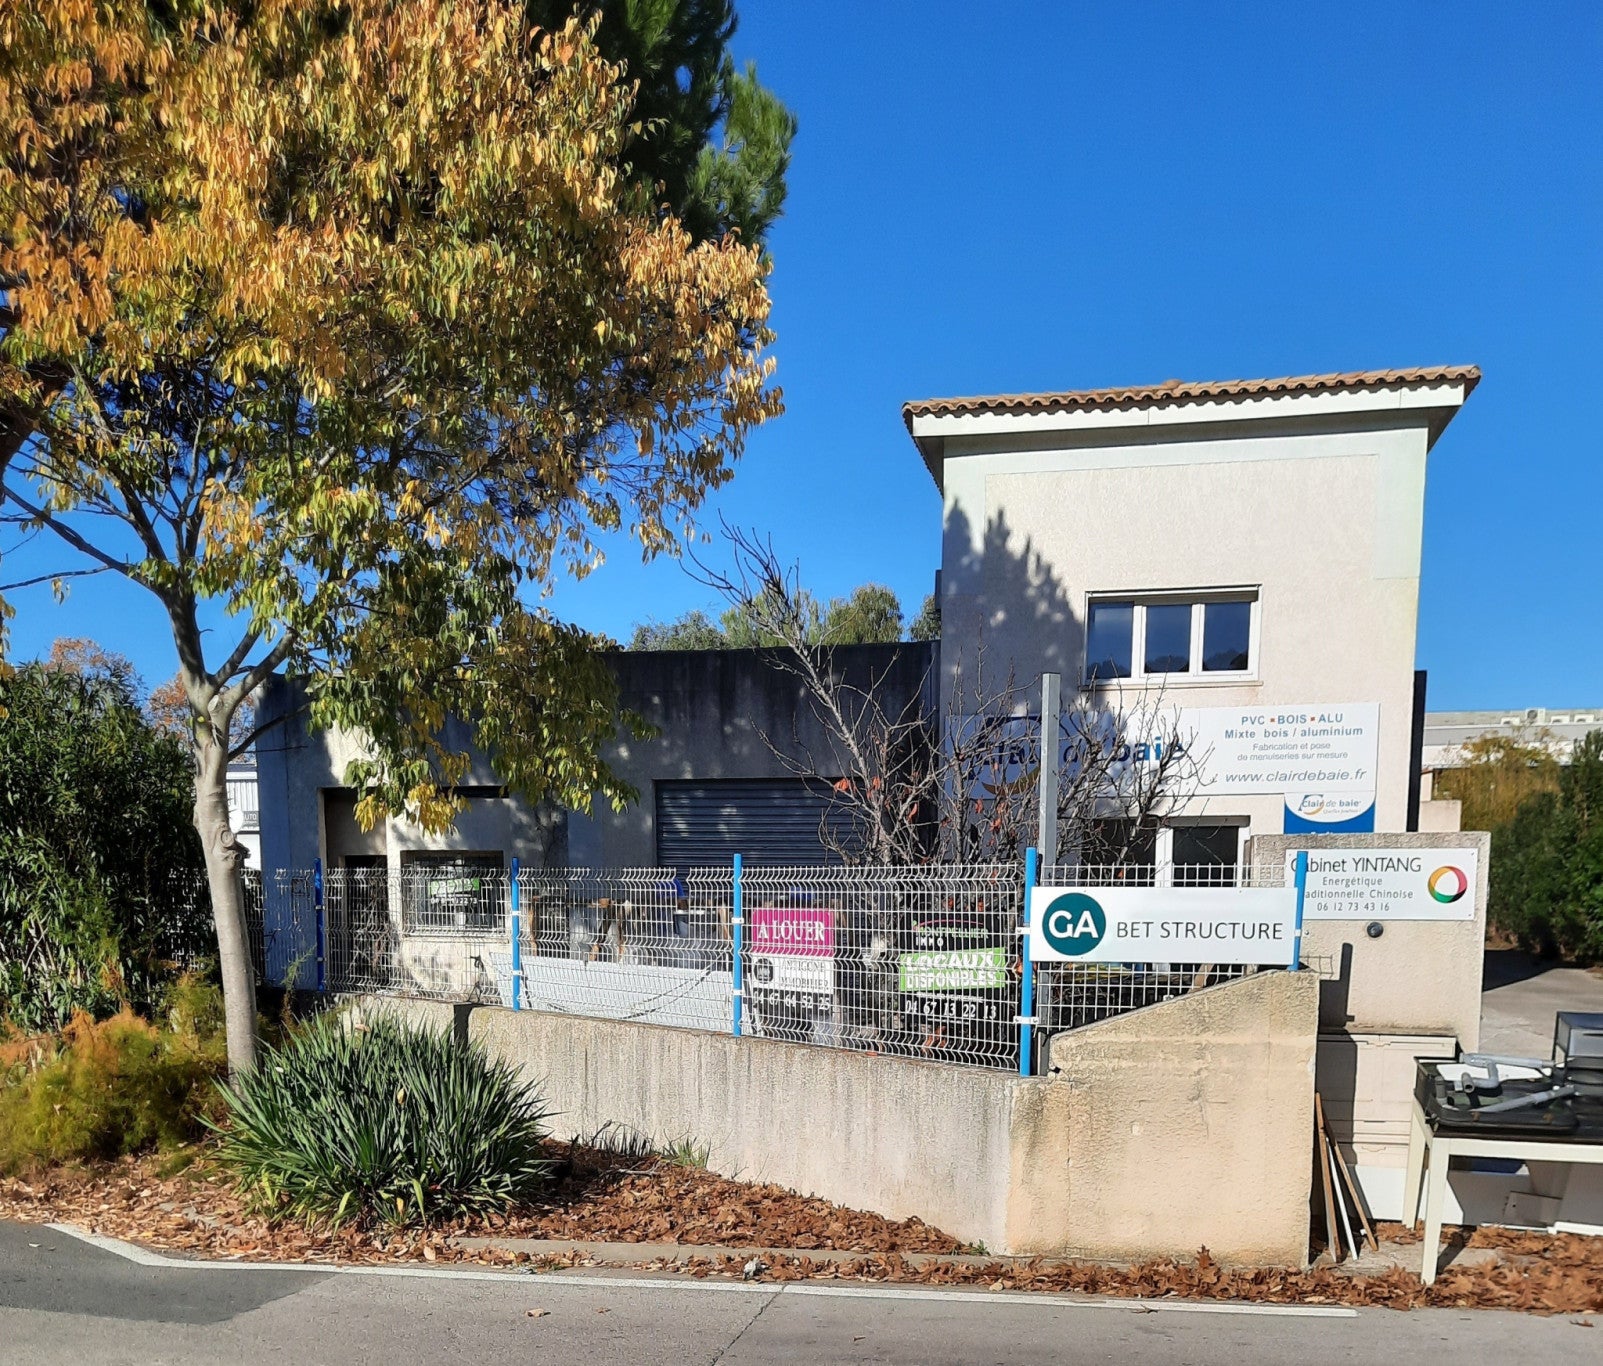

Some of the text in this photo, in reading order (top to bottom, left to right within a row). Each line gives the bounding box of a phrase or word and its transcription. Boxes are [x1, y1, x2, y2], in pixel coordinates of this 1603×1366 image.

[1241, 713, 1344, 726] PVC BOIS ALU
[1224, 729, 1256, 739] Mixte
[1264, 728, 1288, 738] bois
[1300, 726, 1363, 738] aluminium
[1252, 742, 1298, 751] Fabrication
[1310, 743, 1331, 752] pose
[1237, 753, 1248, 761] de
[1249, 753, 1300, 761] menuiseries
[1316, 752, 1348, 760] mesure
[1225, 768, 1367, 783] www.clairdebaie.fr
[1352, 857, 1422, 873] YINTANG
[1370, 889, 1414, 899] Chinoise
[1318, 902, 1391, 911] 06 12 73 43 16
[772, 920, 825, 942] LOUER
[1048, 909, 1099, 939] GA
[1116, 921, 1283, 940] BET STRUCTURE
[906, 951, 994, 971] LOCAUX
[906, 969, 996, 989] DISPONIBLES
[923, 1001, 937, 1015] 67
[943, 1002, 956, 1016] 13
[962, 1003, 976, 1018] 22
[983, 1005, 996, 1019] 13
